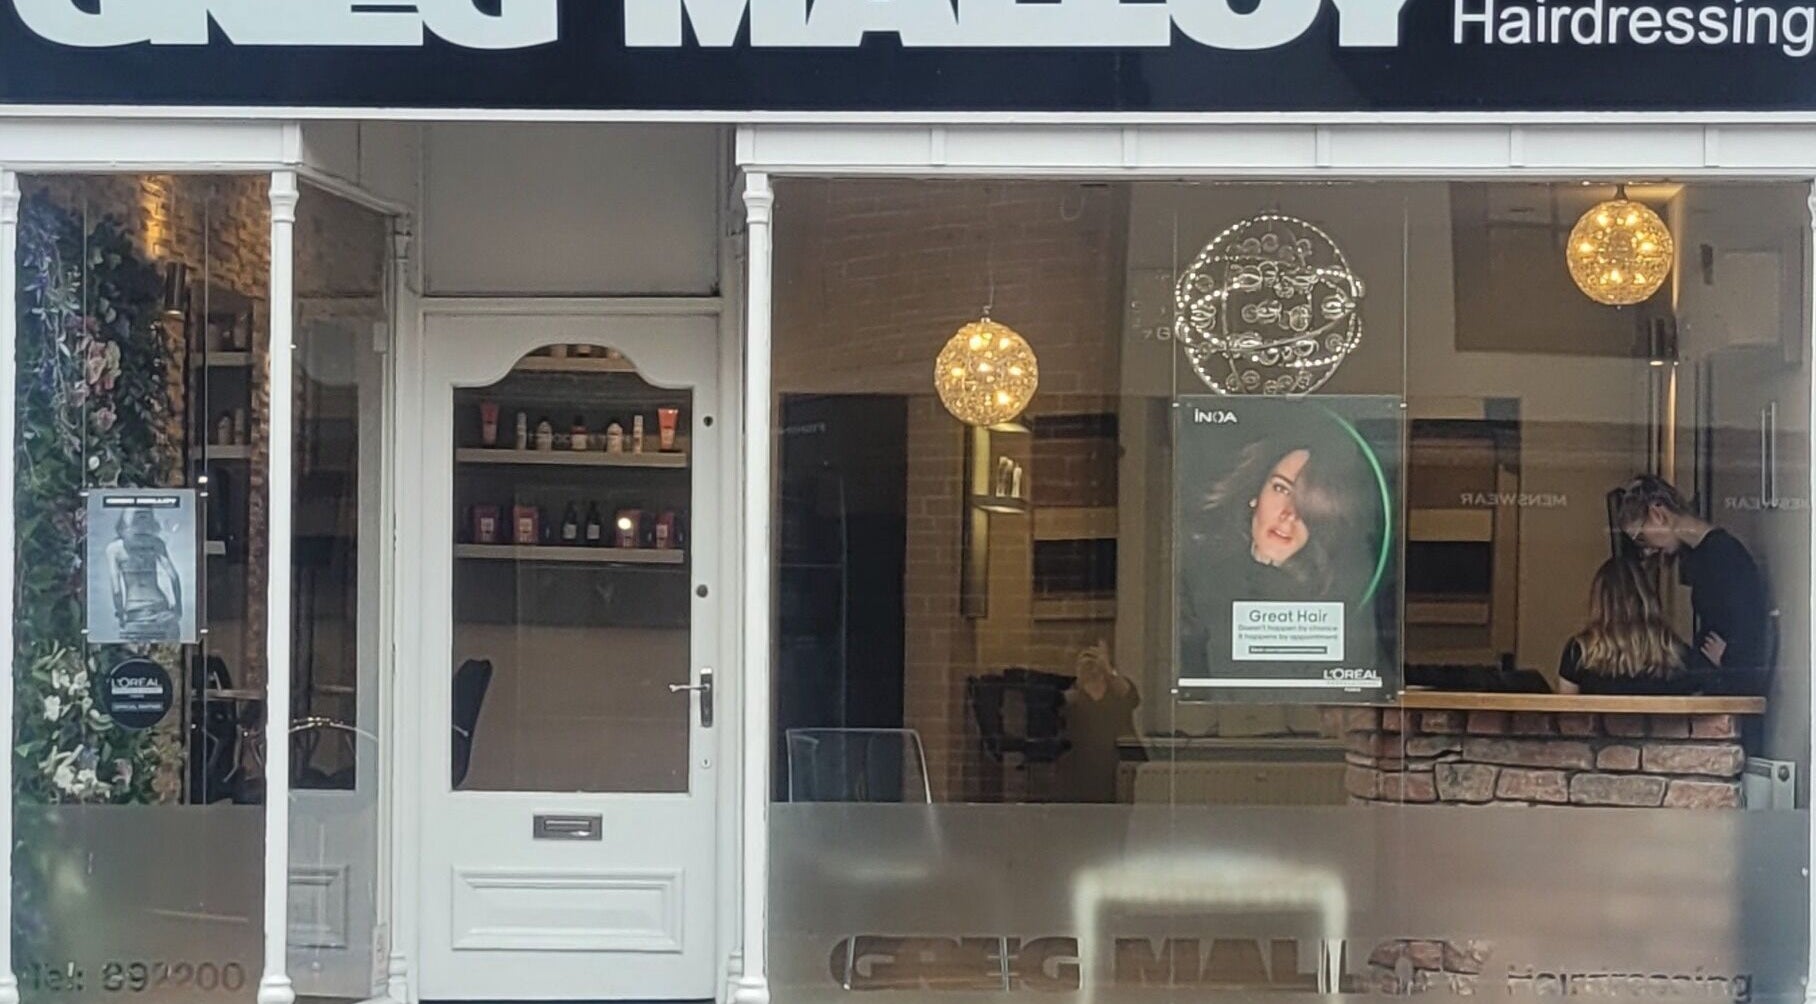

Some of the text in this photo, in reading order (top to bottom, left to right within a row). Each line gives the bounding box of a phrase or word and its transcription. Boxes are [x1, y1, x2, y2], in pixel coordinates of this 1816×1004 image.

[1453, 0, 1815, 57] Hairdressing
[1248, 609, 1328, 623] Great Hair
